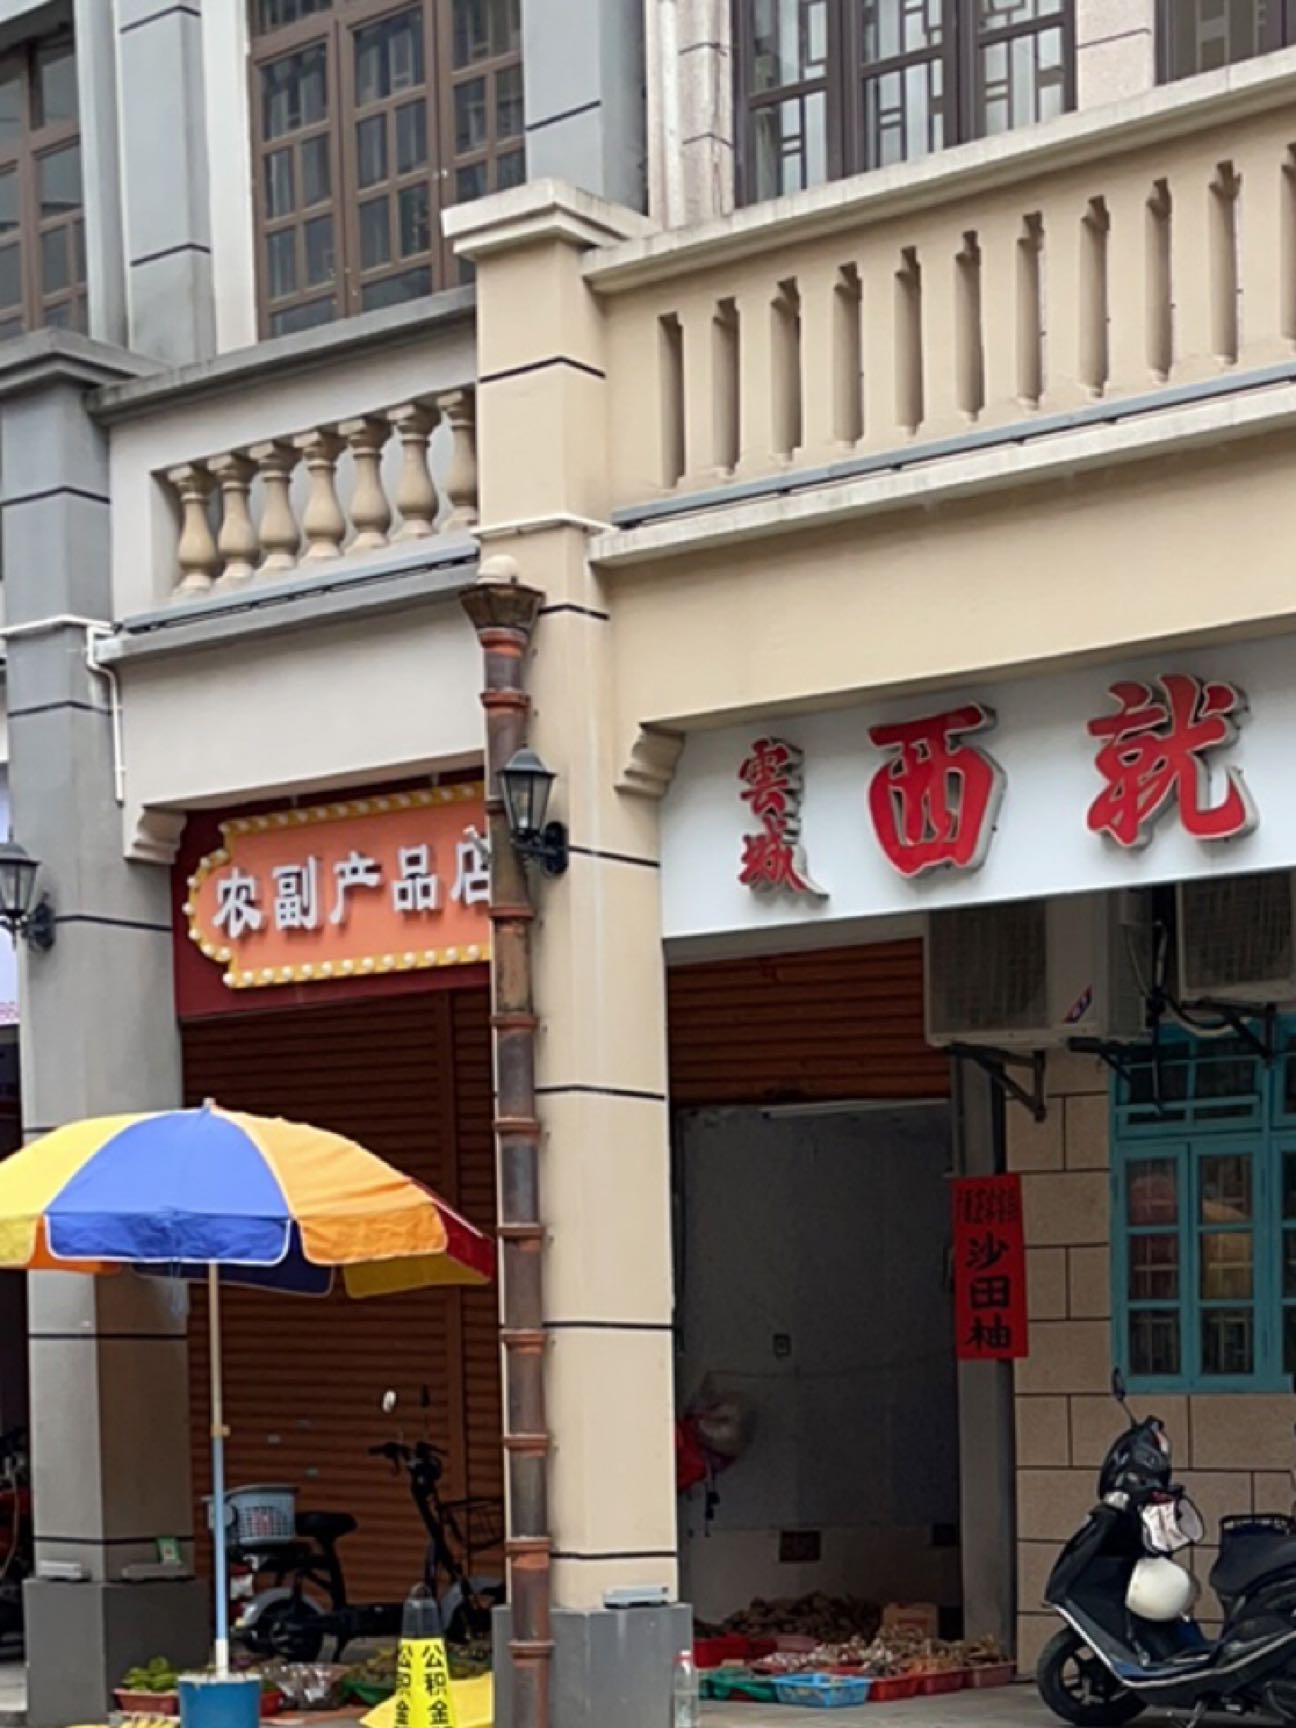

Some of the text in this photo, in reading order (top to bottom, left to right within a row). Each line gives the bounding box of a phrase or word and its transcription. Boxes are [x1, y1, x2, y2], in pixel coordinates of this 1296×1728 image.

[738, 738, 812, 894] 雲城
[212, 838, 490, 939] 农副产品店
